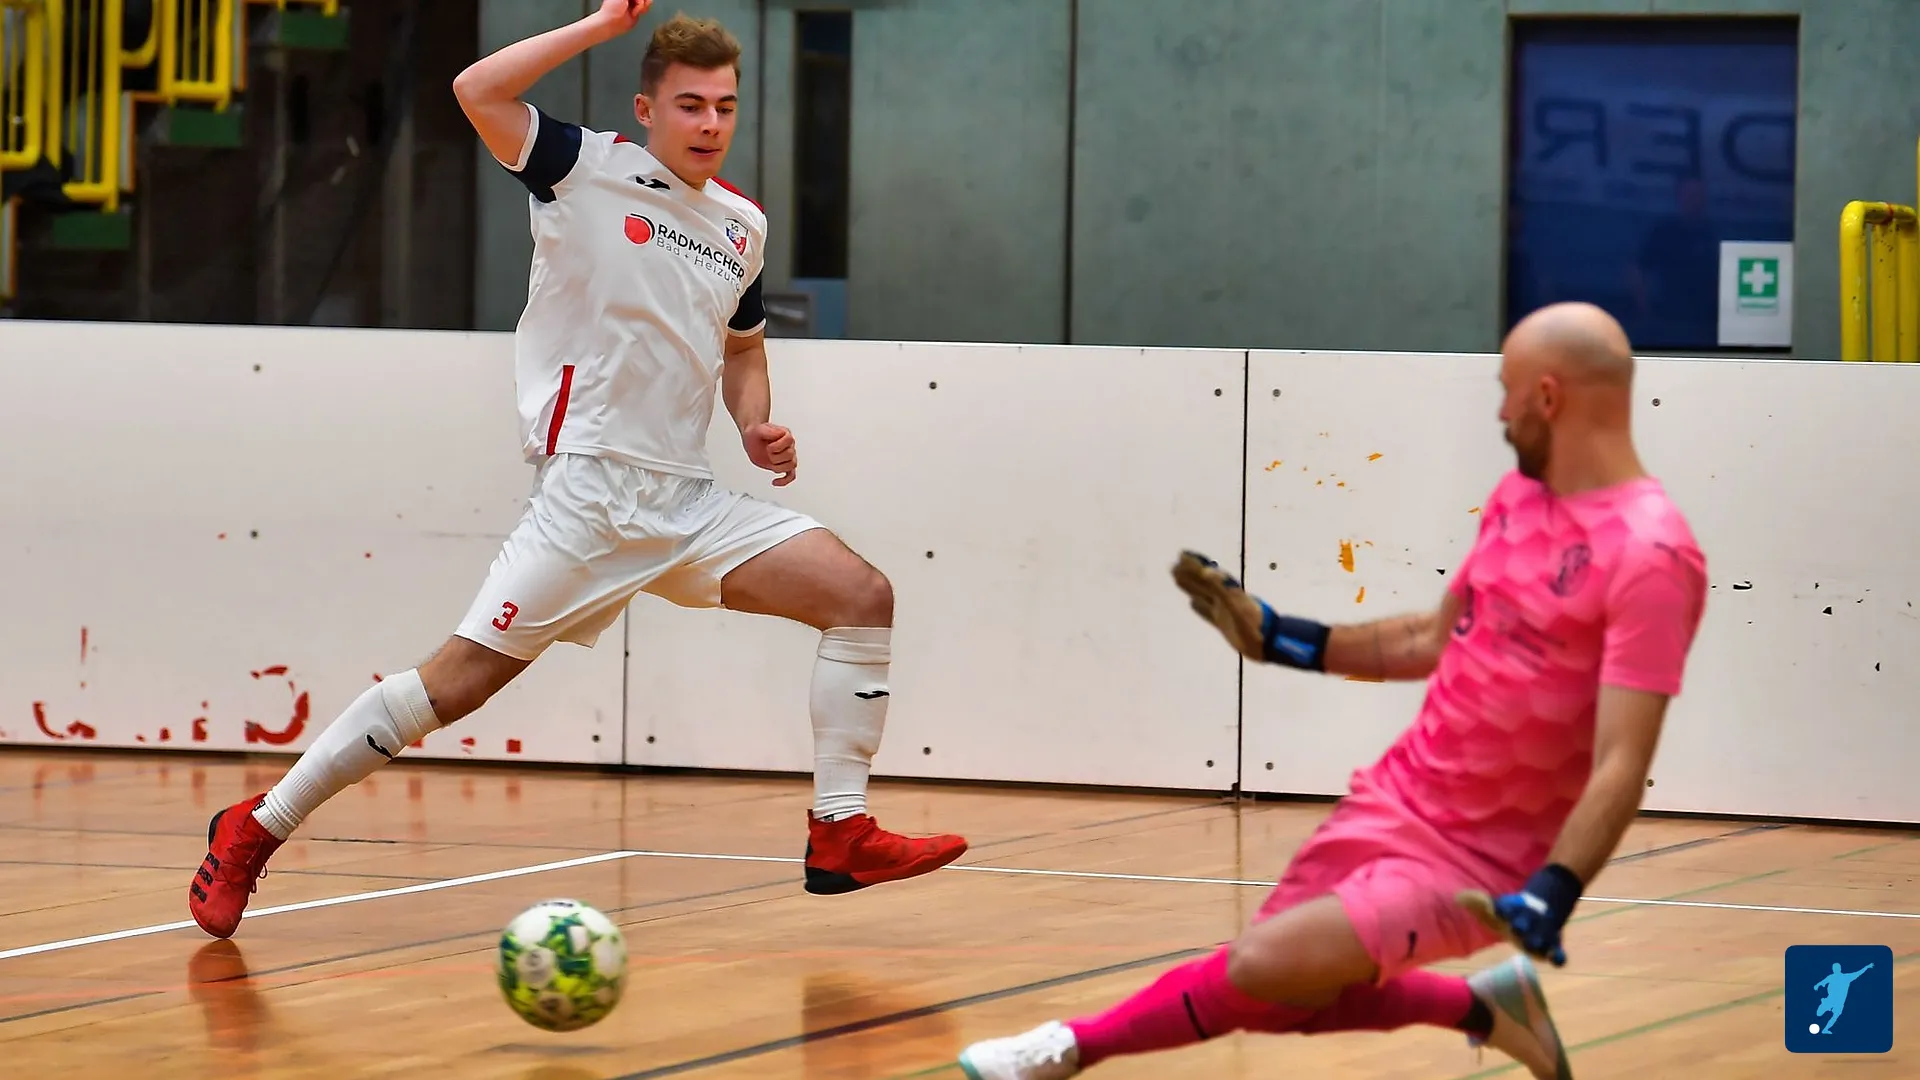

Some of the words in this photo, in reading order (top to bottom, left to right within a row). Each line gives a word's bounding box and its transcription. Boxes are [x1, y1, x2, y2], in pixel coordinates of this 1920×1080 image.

[656, 236, 680, 256] Bad
[658, 223, 745, 282] RADMACHER
[492, 600, 519, 632] 3
